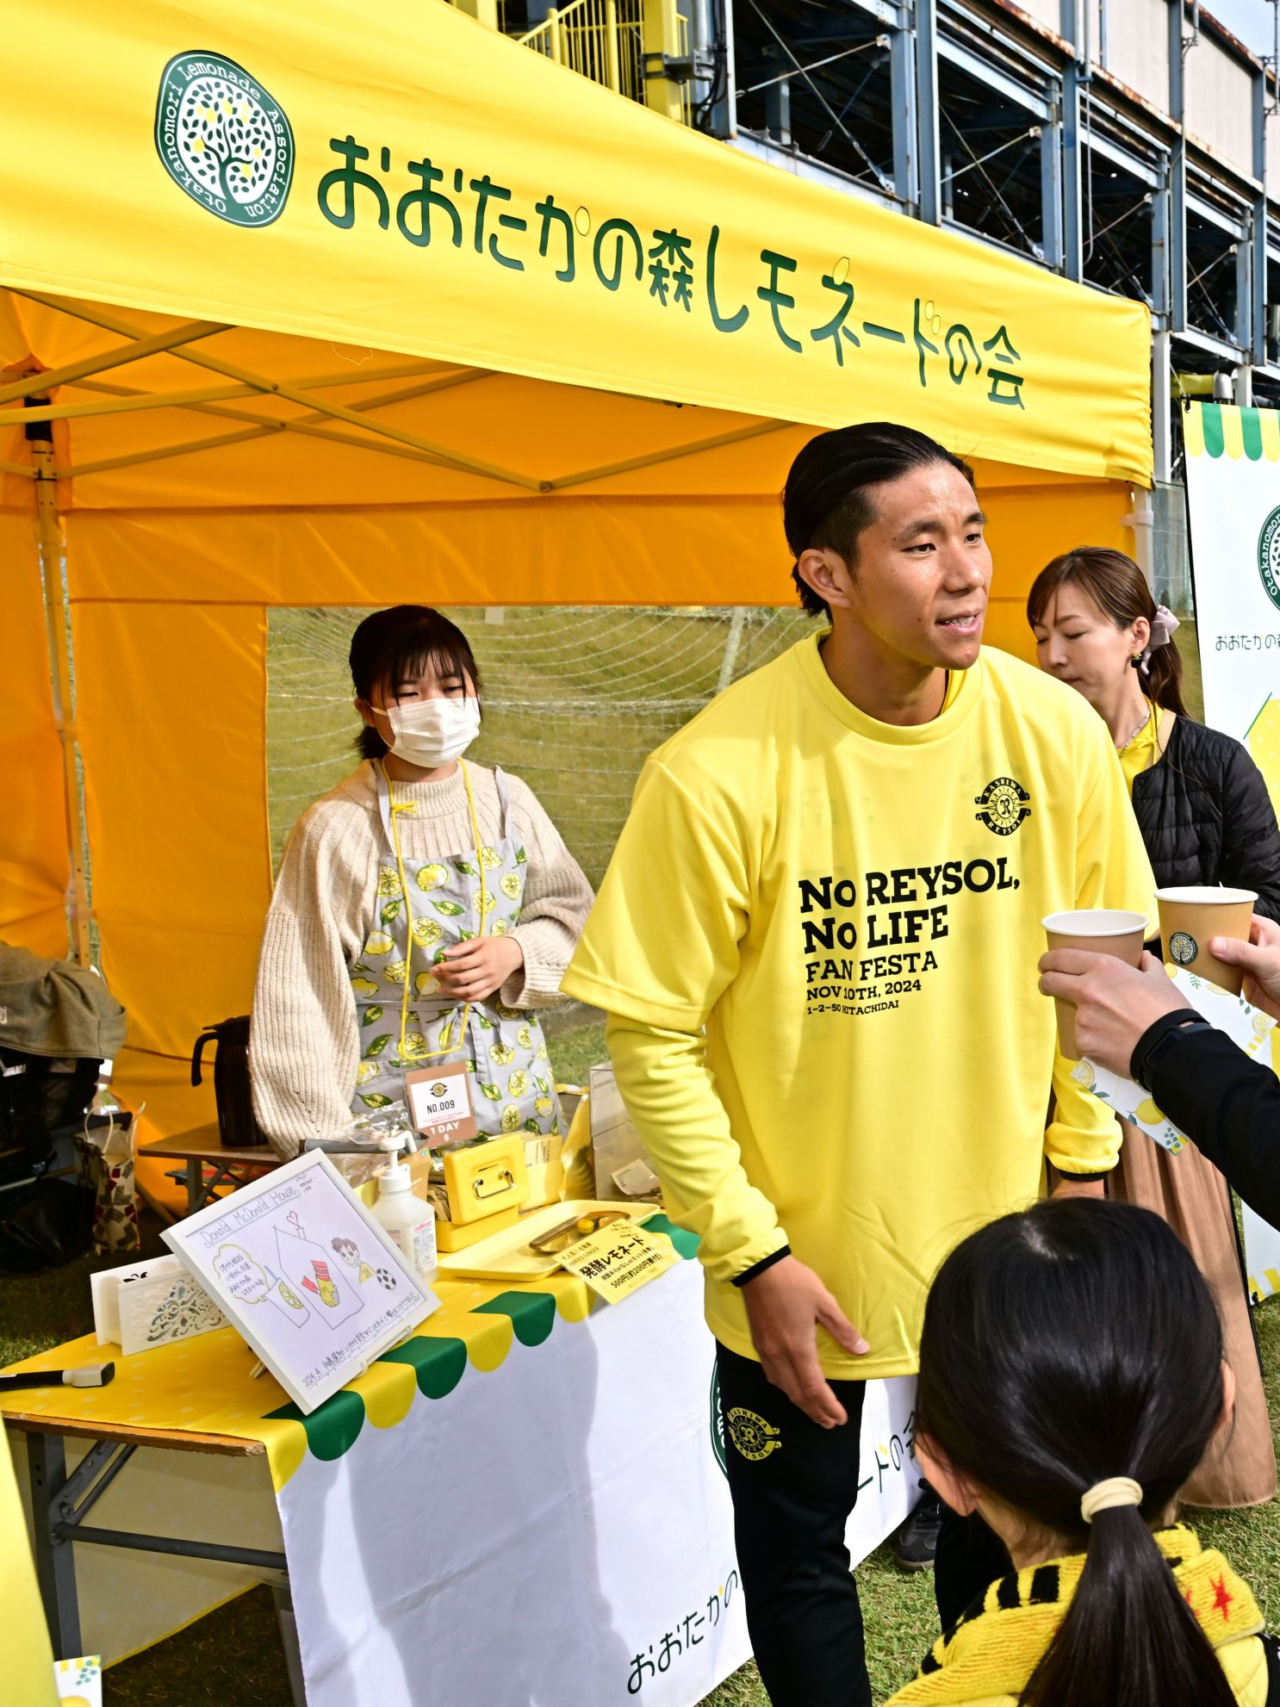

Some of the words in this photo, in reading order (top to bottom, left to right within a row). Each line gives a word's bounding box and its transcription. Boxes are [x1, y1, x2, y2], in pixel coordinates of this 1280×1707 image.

[176, 61, 261, 101] Lemonade
[164, 80, 227, 214] Otakanomori
[243, 108, 287, 218] Association
[983, 778, 1022, 798] KASHIWA
[865, 856, 1021, 908] REYSOL,
[866, 904, 949, 949] LIFE
[805, 959, 854, 983] FAN
[859, 950, 939, 982] FESTA
[806, 985, 842, 1001] NOV
[843, 985, 882, 1001] 10TH,
[884, 979, 922, 996] 2024
[841, 999, 900, 1016] HITACHIDAI
[437, 1121, 460, 1134] DAY
[200, 1220, 233, 1245] Donald
[232, 1197, 271, 1227] McDonald
[268, 1186, 296, 1207] House
